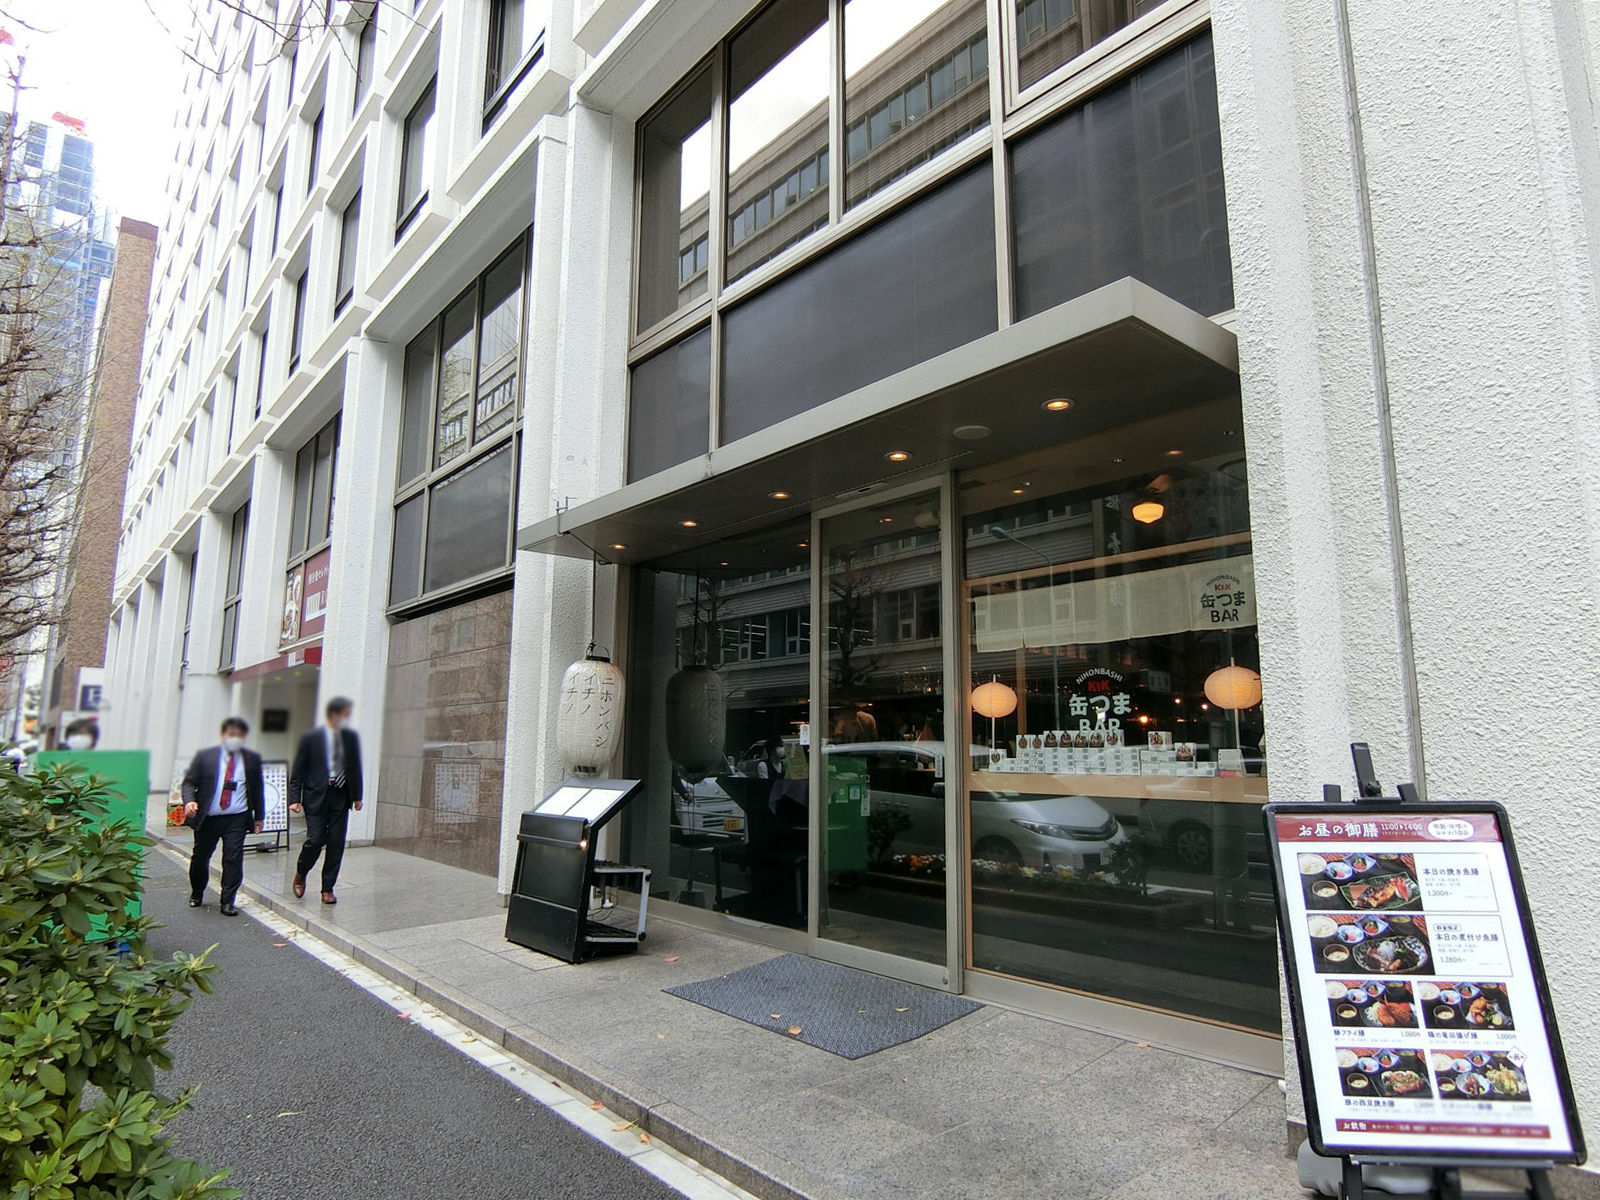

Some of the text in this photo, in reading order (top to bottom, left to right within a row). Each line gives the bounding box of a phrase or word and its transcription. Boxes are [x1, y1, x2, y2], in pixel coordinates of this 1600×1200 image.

[1205, 574, 1241, 587] NIHONBASHI
[1200, 590, 1246, 609] 缶つま
[1210, 608, 1239, 623] BAR
[1075, 668, 1123, 685] NIHONBASHI
[580, 674, 597, 716] イチノ
[1068, 692, 1132, 716] 缶つま
[595, 677, 615, 748] ニホンバシ
[1079, 718, 1121, 737] BAR
[1298, 822, 1379, 837] お昼の御膳
[1343, 1121, 1367, 1131] お飲物
